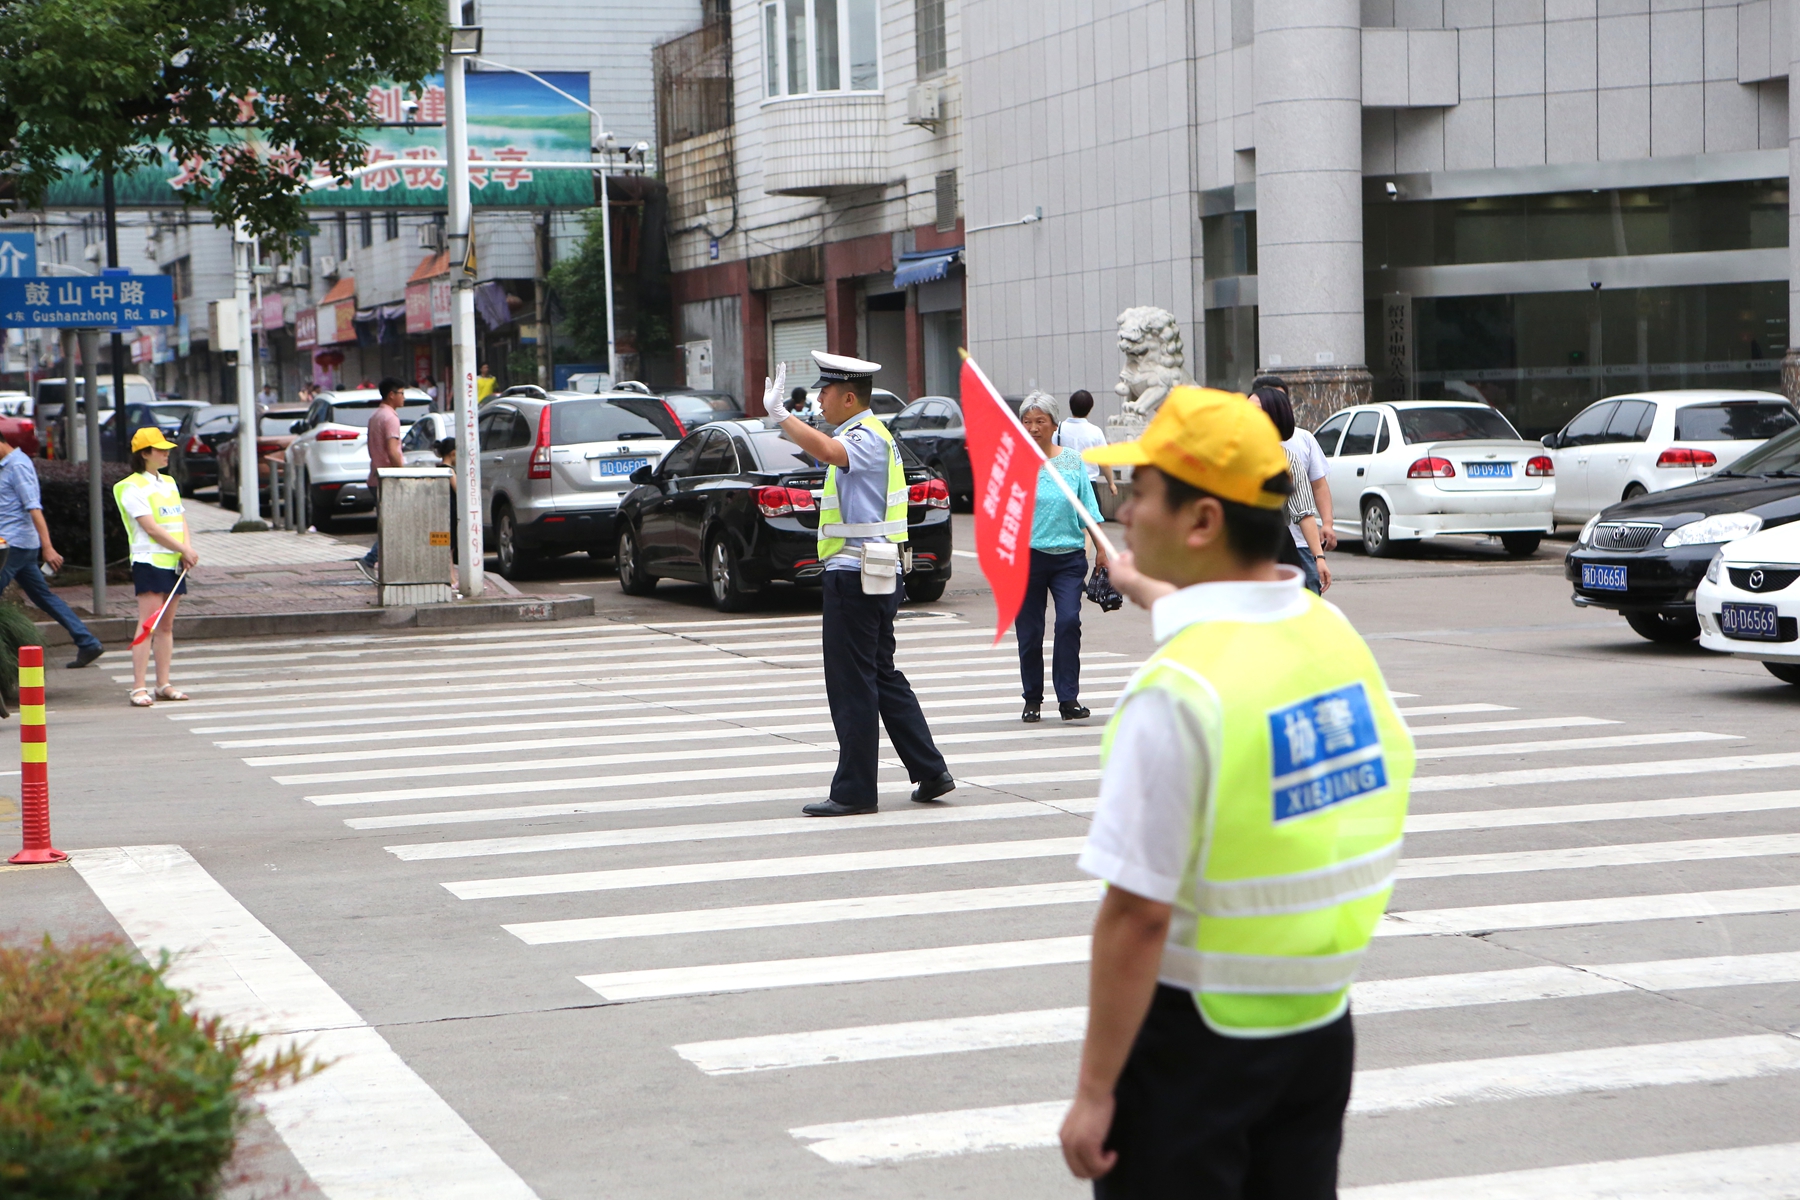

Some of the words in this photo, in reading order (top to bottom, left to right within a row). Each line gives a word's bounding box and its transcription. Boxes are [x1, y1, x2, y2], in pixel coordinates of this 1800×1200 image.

[25, 281, 145, 306] 鼓山中路
[14, 311, 25, 322] 东
[33, 310, 118, 323] Gushanzhong
[124, 309, 143, 321] Rd.
[150, 309, 160, 319] 西
[1286, 763, 1378, 815] XIEJING
